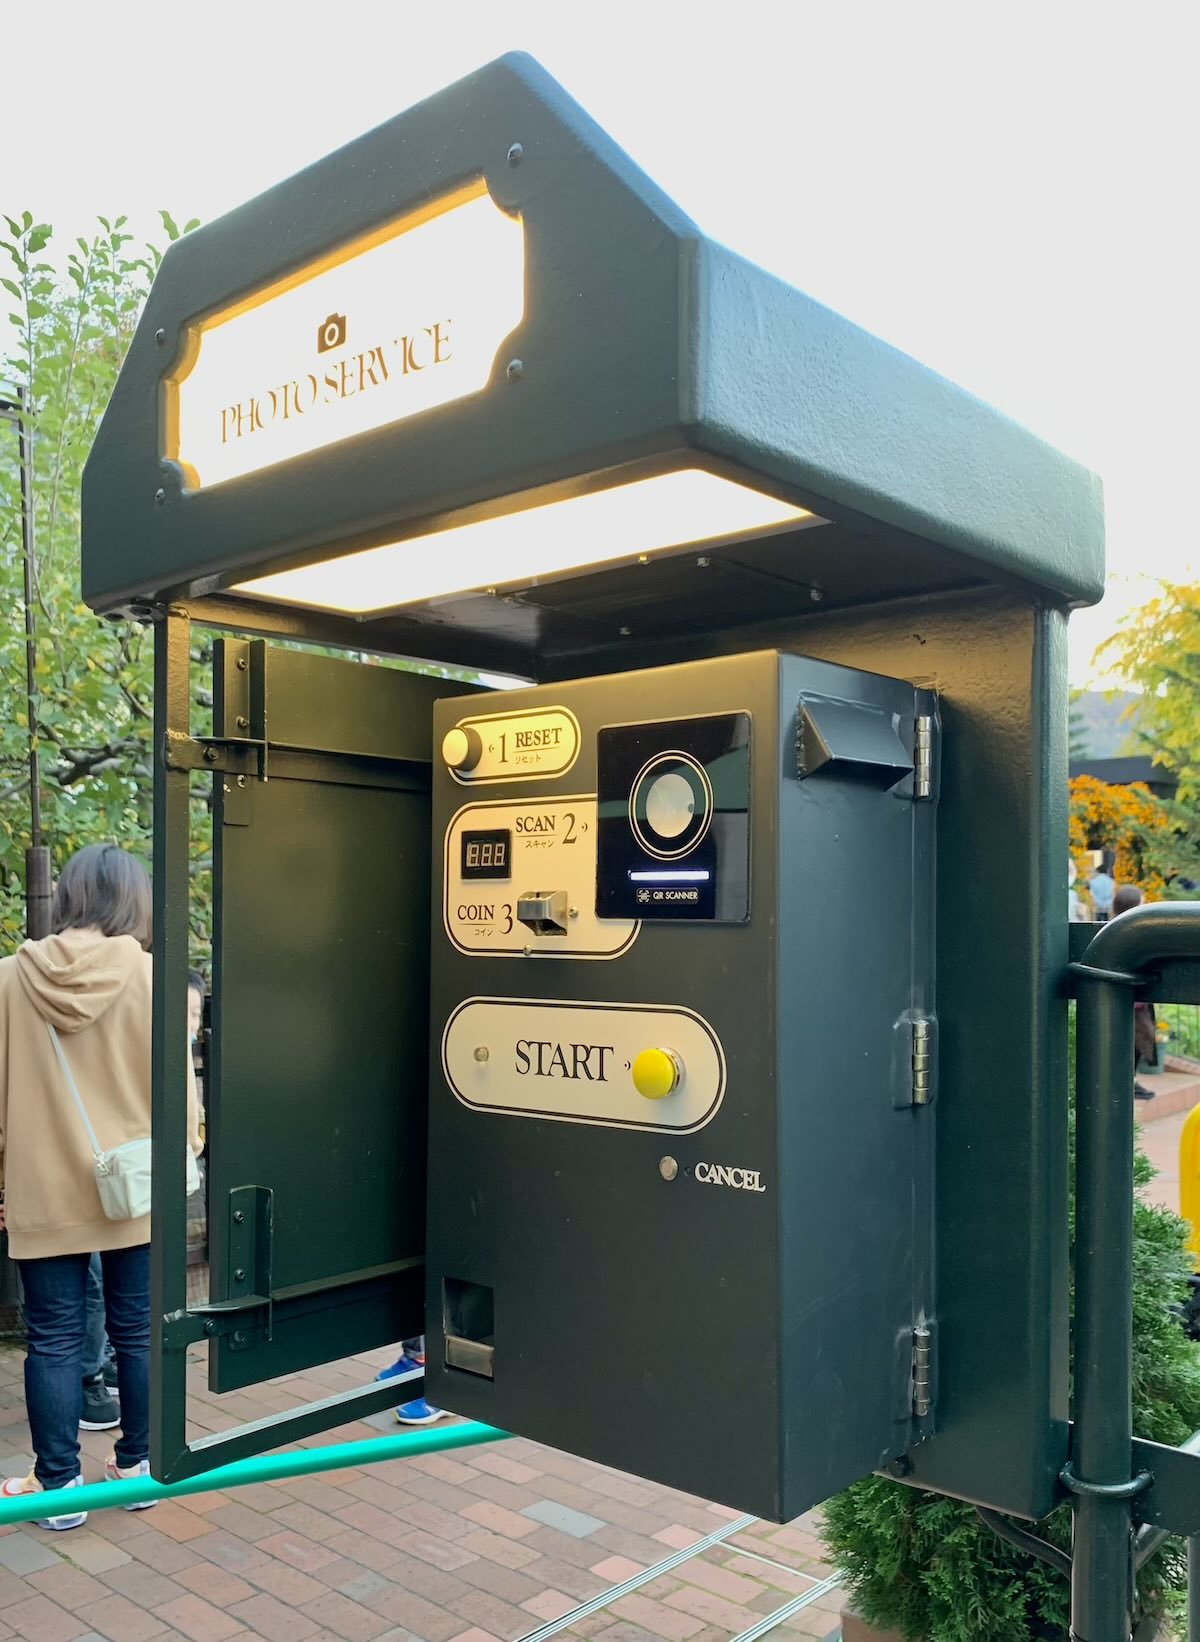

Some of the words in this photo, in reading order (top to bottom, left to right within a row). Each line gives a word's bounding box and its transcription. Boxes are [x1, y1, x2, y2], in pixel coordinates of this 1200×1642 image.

[221, 373, 317, 443] PHOTO
[324, 318, 452, 403] SERVICE
[499, 732, 509, 763] 1
[515, 727, 563, 748] RESET
[515, 753, 541, 764] リセット
[515, 815, 556, 833] SCAN
[562, 812, 577, 845] 2
[525, 840, 555, 849] スキャン
[652, 891, 664, 900] QR
[665, 891, 698, 900] SCANNER
[457, 904, 495, 920] COIN
[500, 904, 513, 935] 3
[474, 928, 494, 937] コイン
[515, 1039, 614, 1082] START
[694, 1161, 766, 1192] CANCEL
